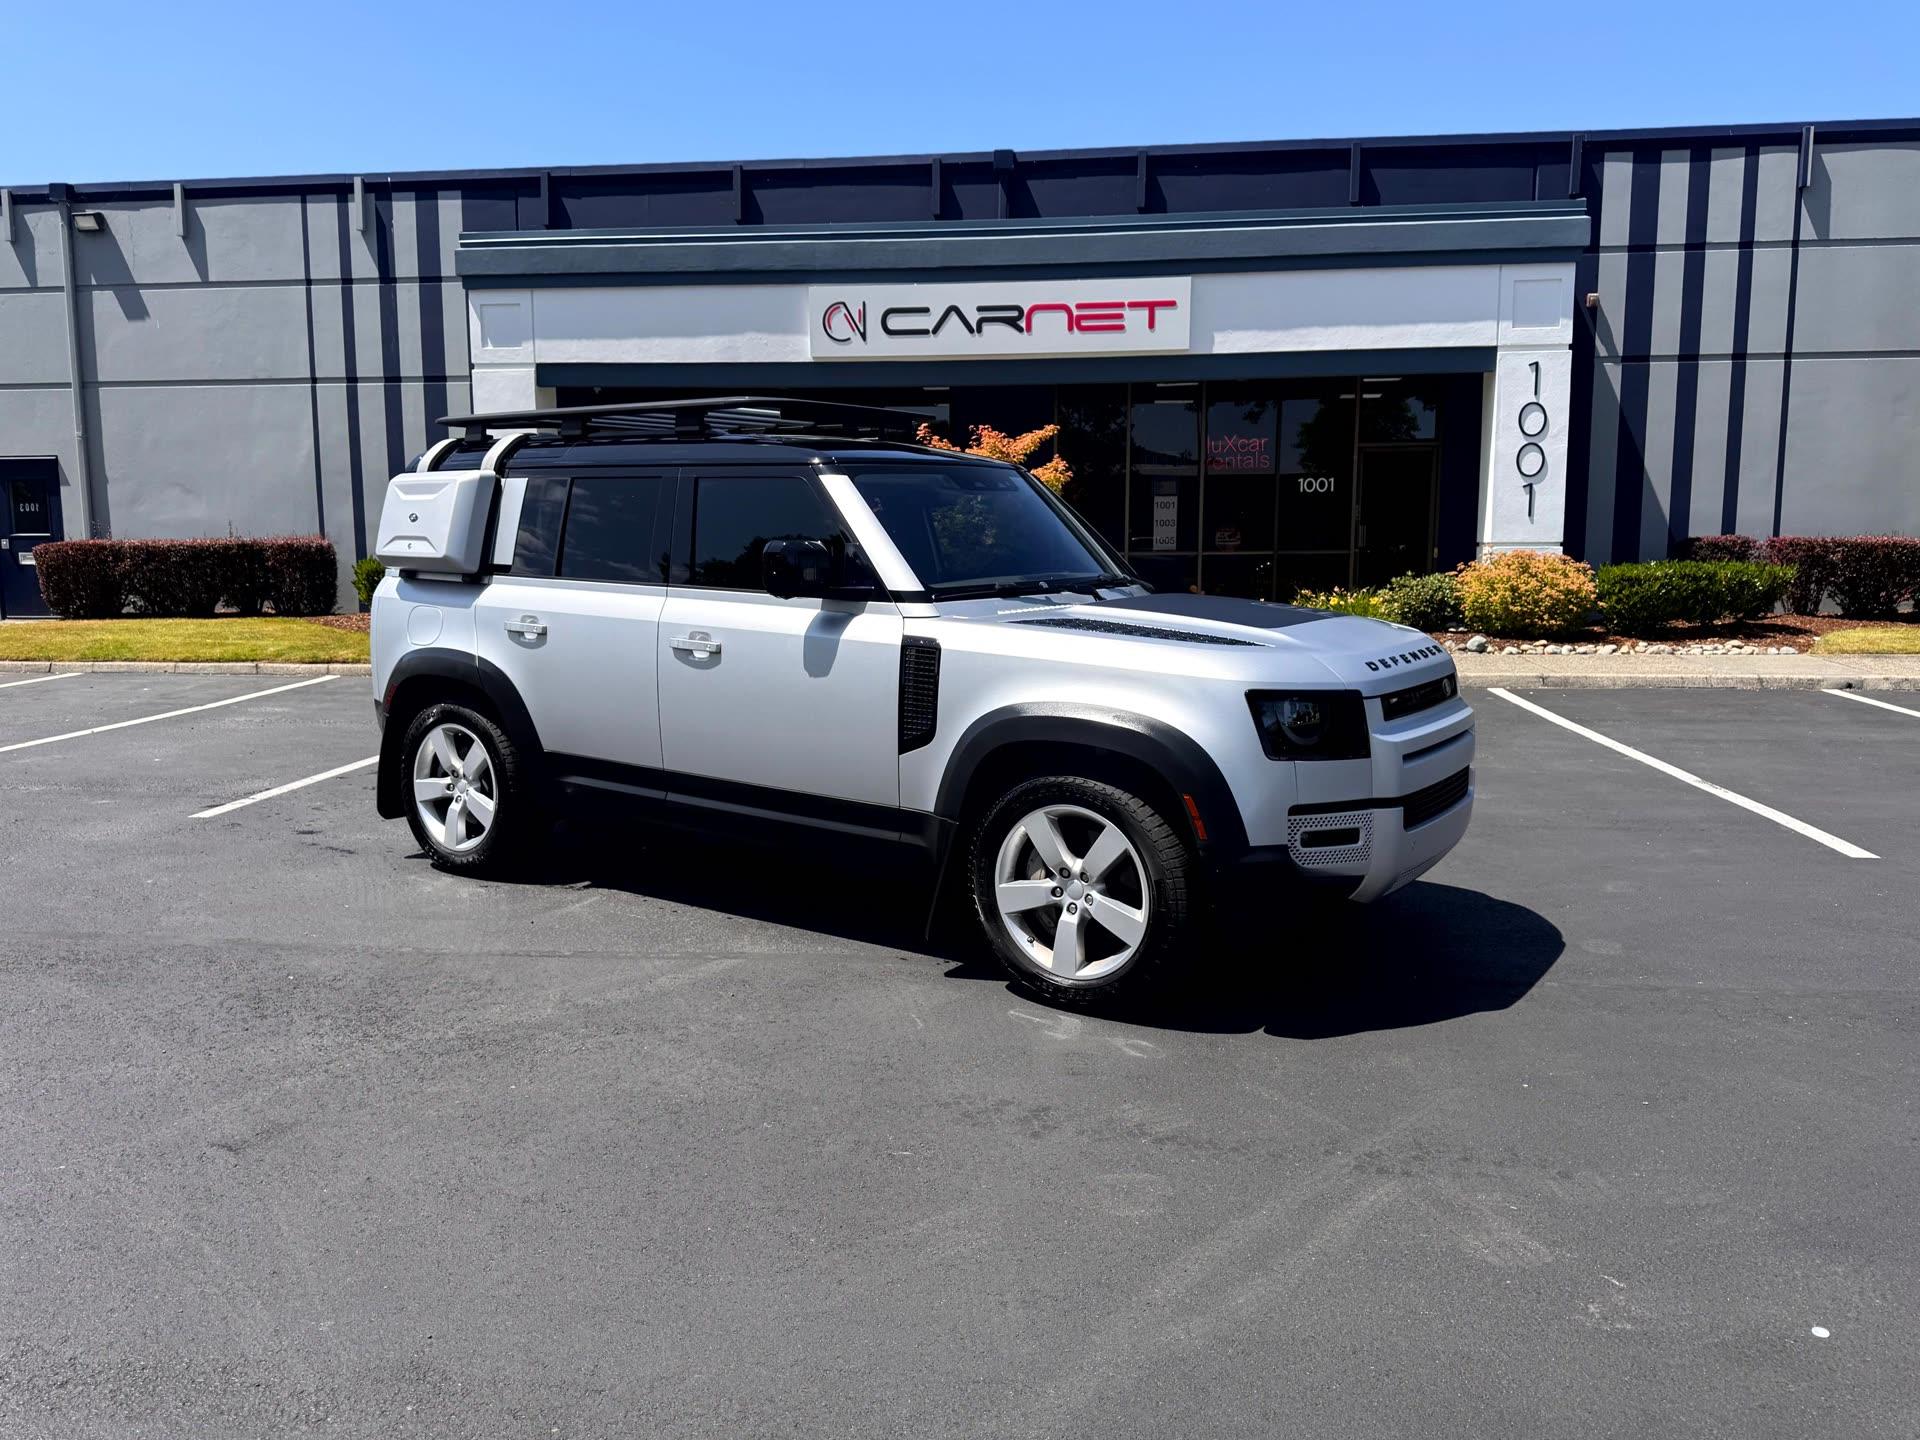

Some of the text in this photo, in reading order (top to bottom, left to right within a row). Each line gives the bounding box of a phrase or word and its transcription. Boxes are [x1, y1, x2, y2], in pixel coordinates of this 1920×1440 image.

[881, 299, 1177, 336] CARNET
[1516, 361, 1547, 518] 1001
[1298, 477, 1335, 493] 1001
[1155, 501, 1176, 510] 1001
[1155, 519, 1177, 528] 1003
[1365, 645, 1443, 672] DEFENDER
